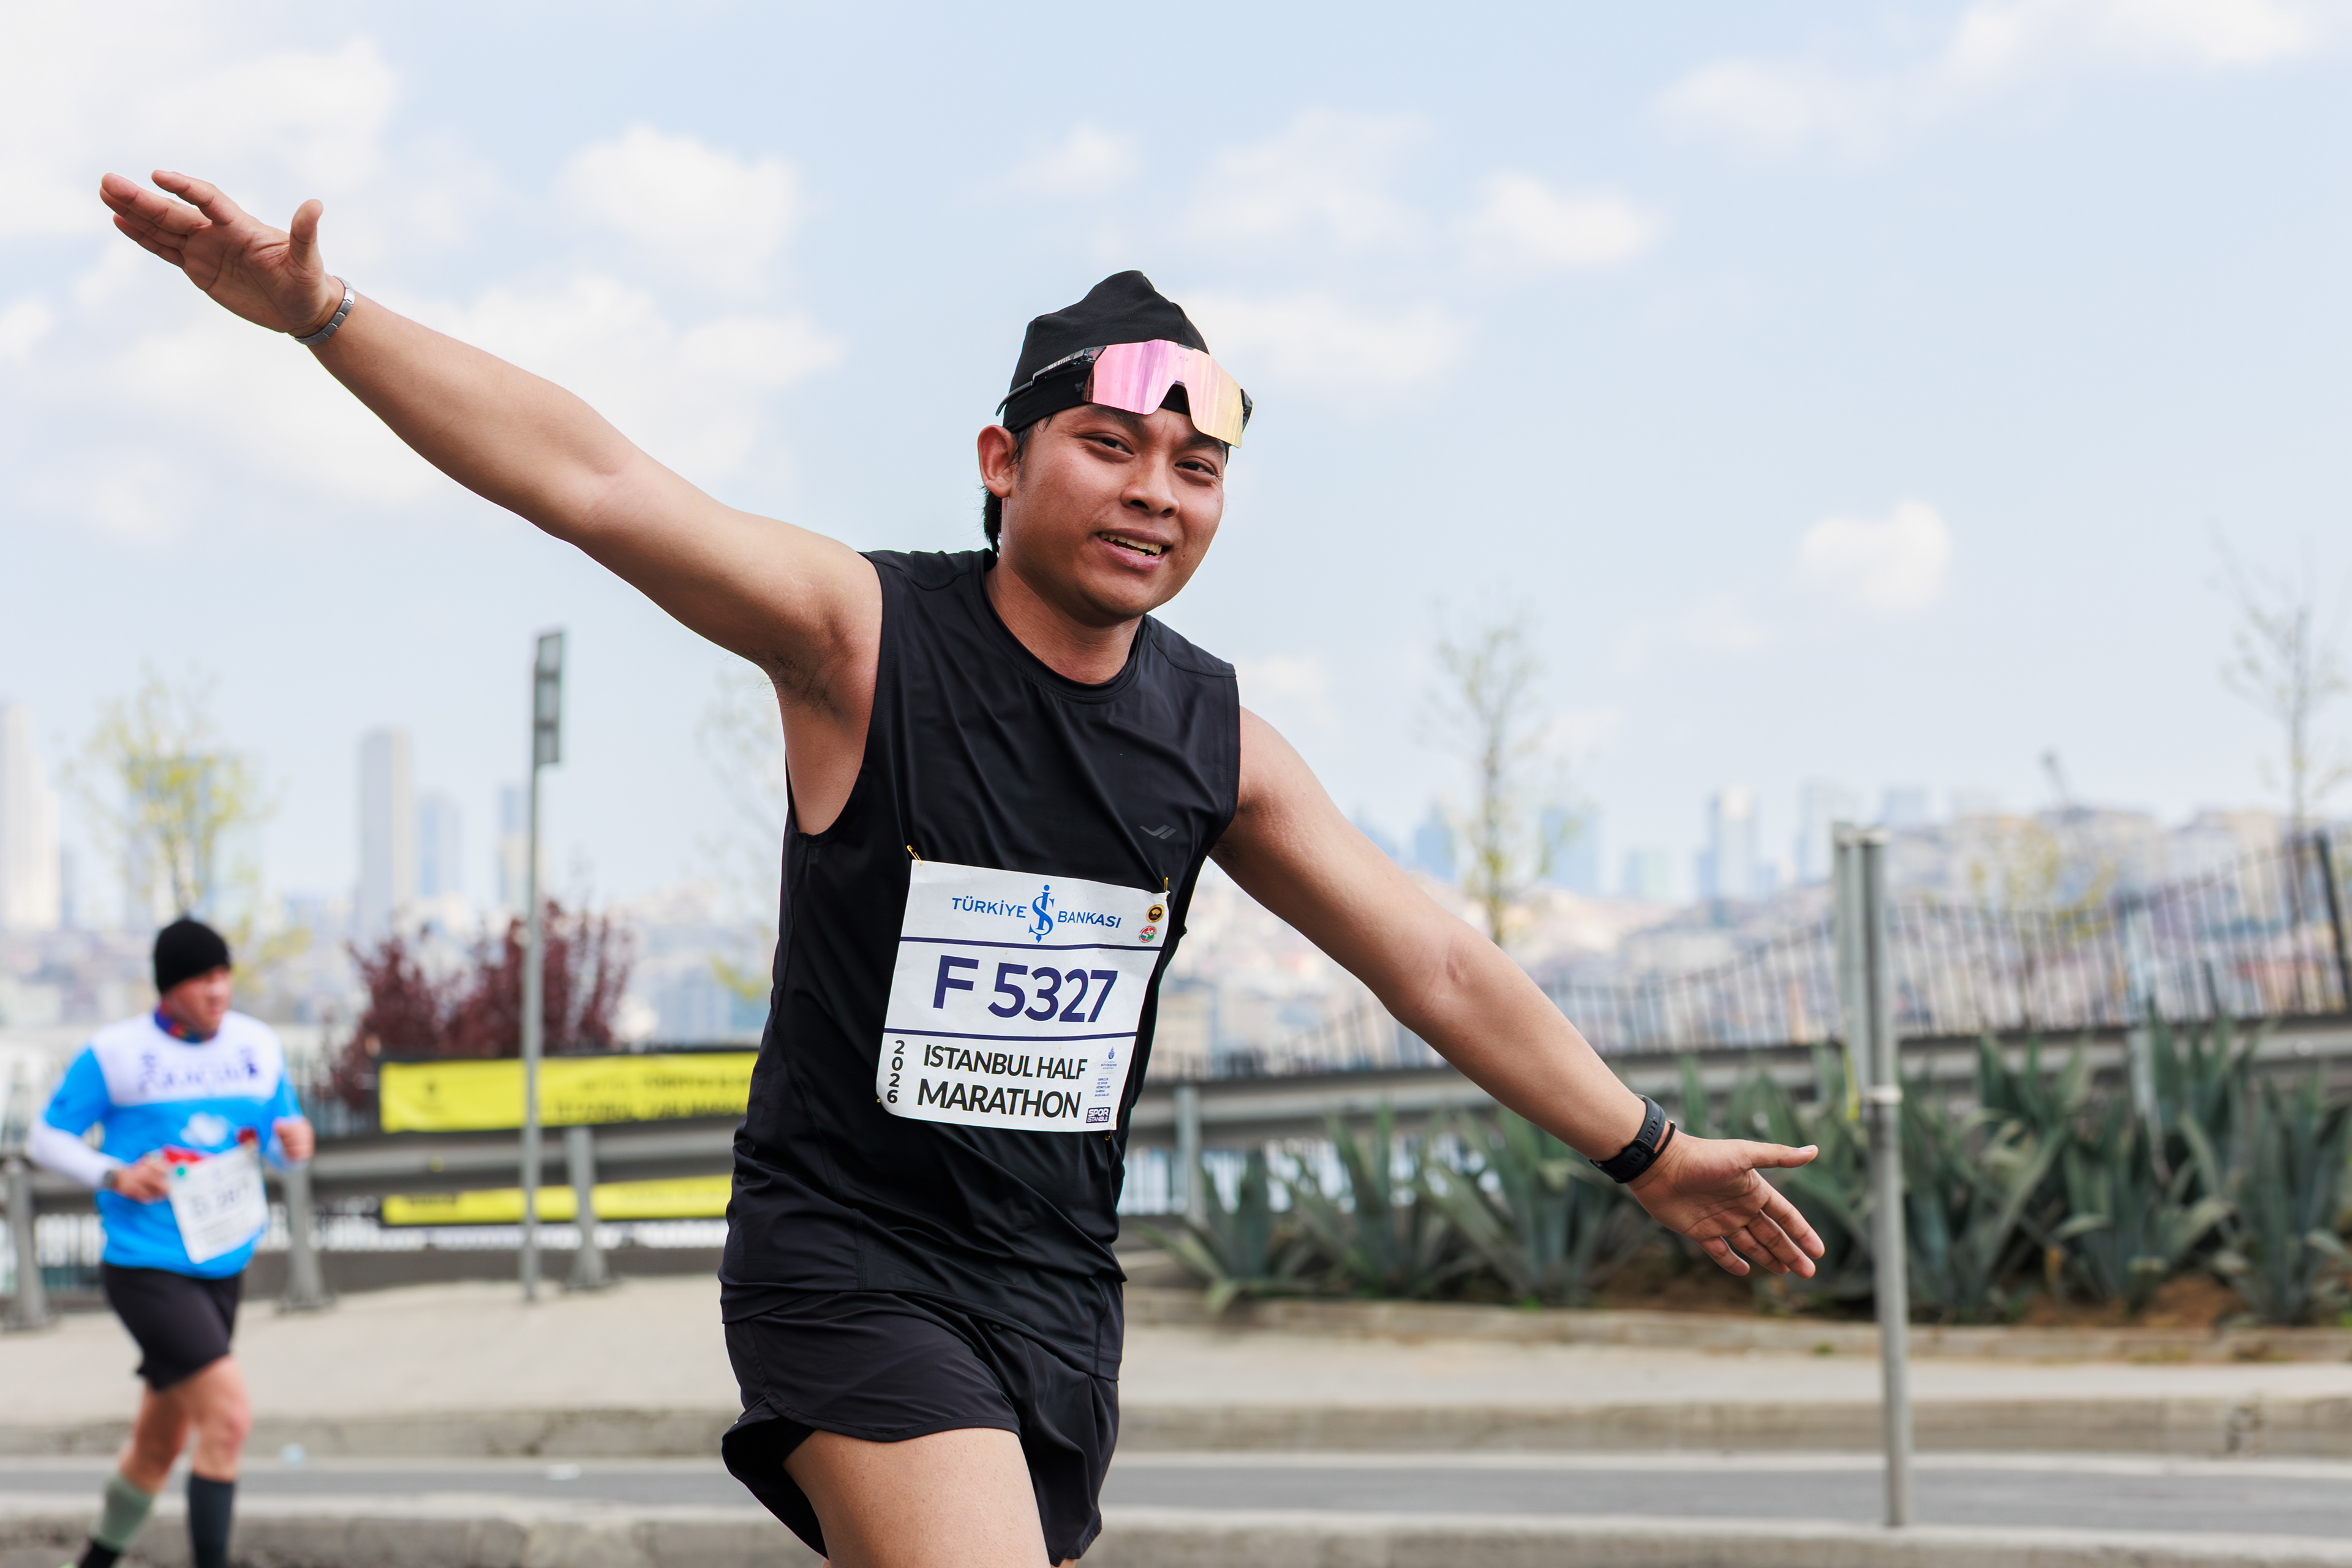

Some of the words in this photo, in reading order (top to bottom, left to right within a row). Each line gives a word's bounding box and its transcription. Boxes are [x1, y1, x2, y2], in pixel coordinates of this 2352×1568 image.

[952, 895, 1027, 919] TÜRKİYE
[1058, 911, 1121, 928] BANKASI
[933, 955, 979, 1009] F
[987, 962, 1118, 1022] 5327
[924, 1044, 1033, 1077] ISTANBUL
[1036, 1057, 1088, 1080] HALF
[918, 1078, 1082, 1118] MARATHON
[1087, 1108, 1109, 1117] SPOR
